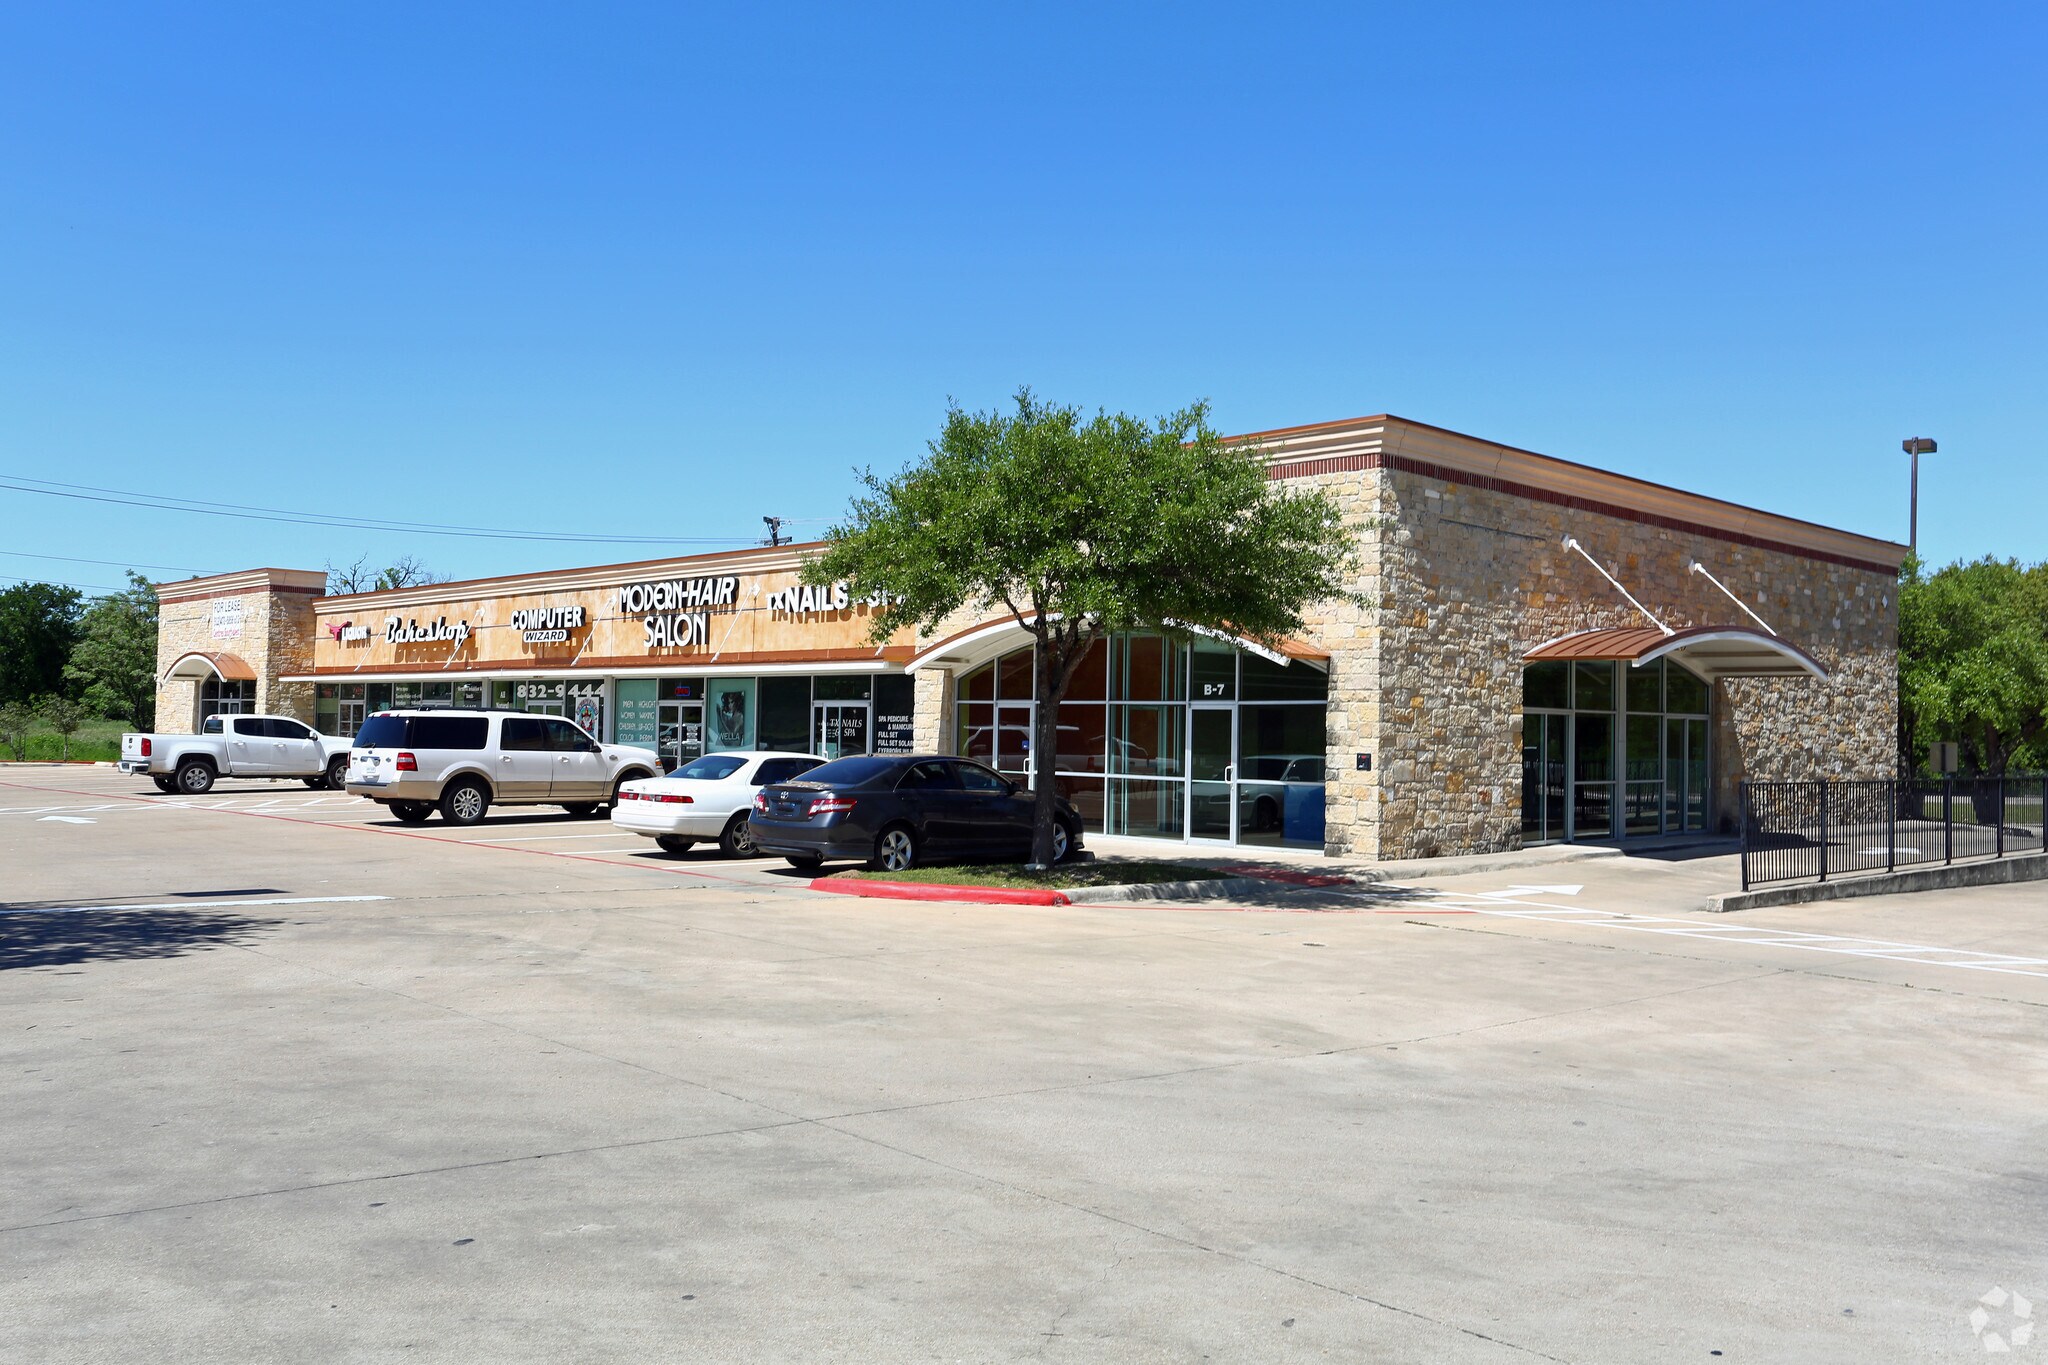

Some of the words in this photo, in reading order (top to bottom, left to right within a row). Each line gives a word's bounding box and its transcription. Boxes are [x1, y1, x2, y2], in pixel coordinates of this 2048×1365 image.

[618, 576, 737, 613] MODERN-HAIR
[785, 581, 848, 613] NAILS
[214, 602, 224, 613] FOR
[225, 600, 241, 612] LEASE
[510, 606, 584, 630] COMPUTER
[341, 626, 368, 641] LIQUOR
[384, 615, 470, 647] Bakeshop
[524, 631, 565, 641] WIZARD
[643, 613, 707, 648] SALON
[1203, 684, 1225, 696] B-7
[841, 718, 863, 728] NAILS
[892, 723, 914, 731] MANICUR
[843, 728, 856, 737] SPA
[889, 739, 898, 747] SET
